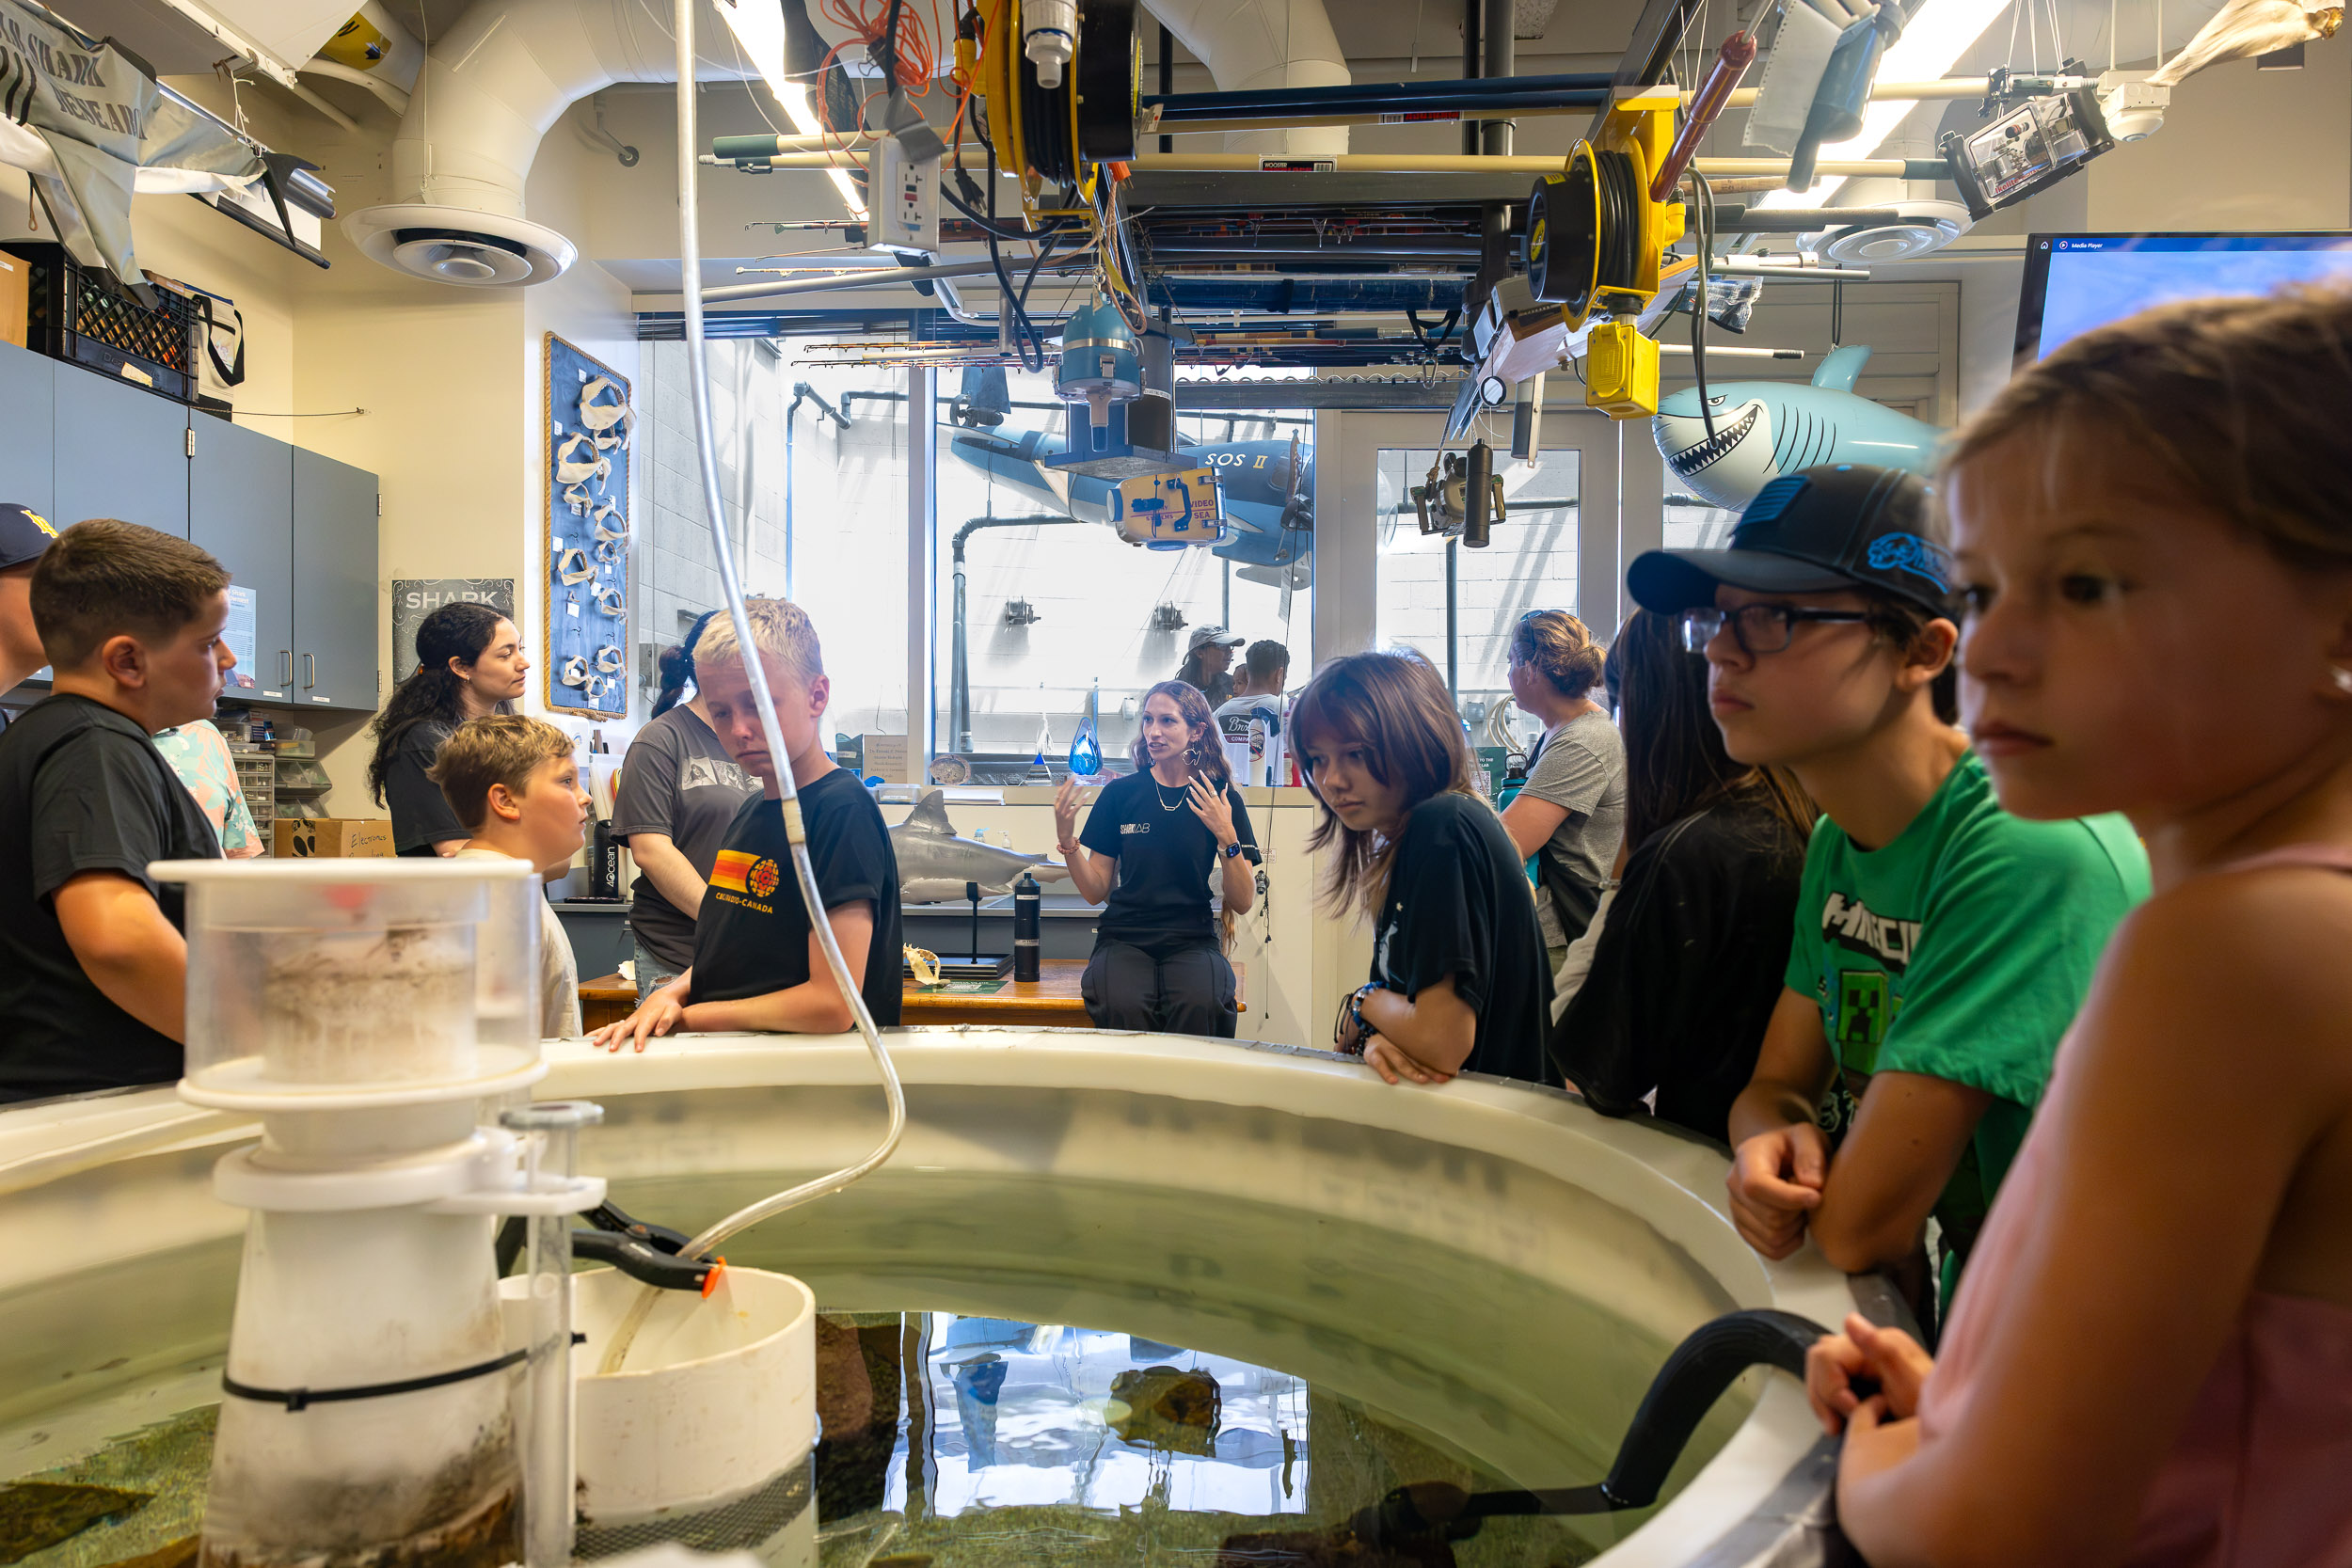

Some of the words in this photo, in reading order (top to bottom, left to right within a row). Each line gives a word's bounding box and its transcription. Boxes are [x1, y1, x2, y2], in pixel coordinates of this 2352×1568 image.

[28, 33, 106, 87] SHARK
[1204, 452, 1247, 467] SOS
[1252, 454, 1268, 468] II
[1190, 499, 1214, 508] VIDEO
[1193, 511, 1211, 519] SEA
[405, 591, 499, 610] SHARK
